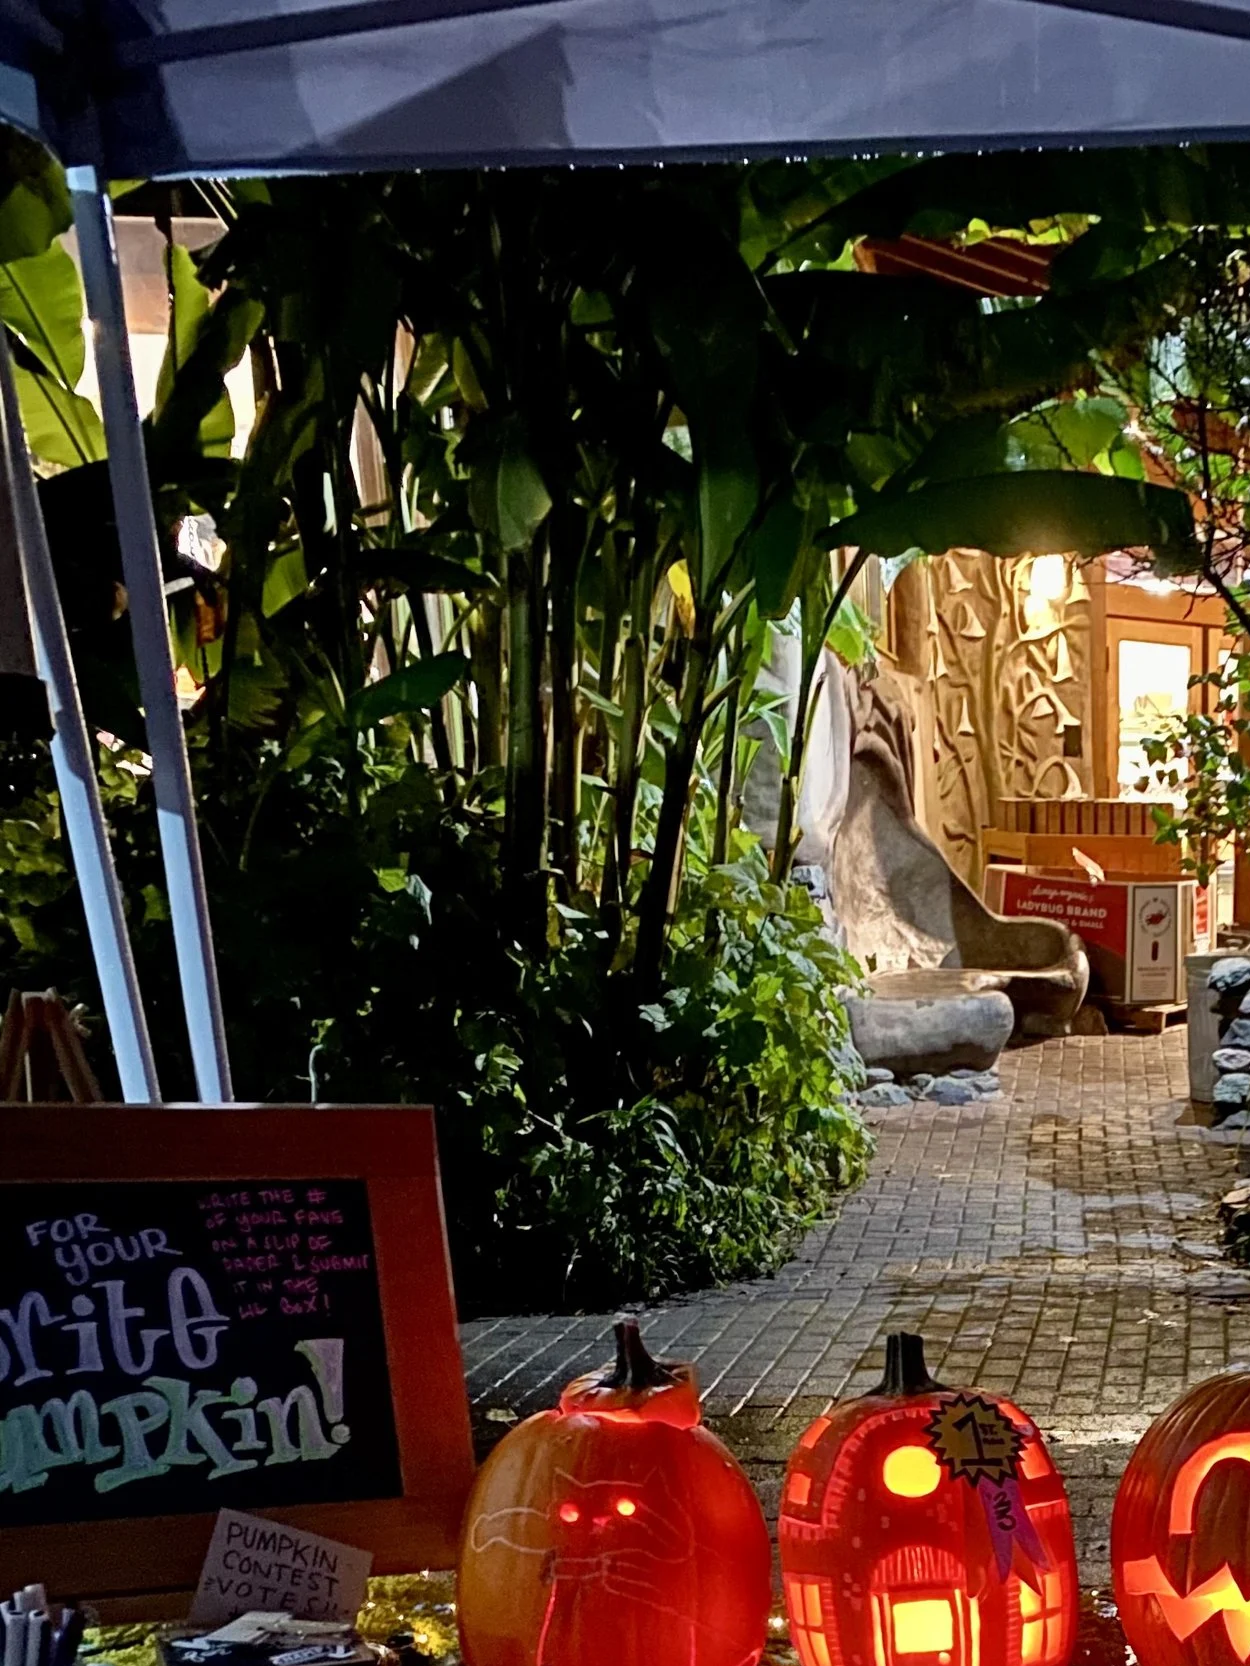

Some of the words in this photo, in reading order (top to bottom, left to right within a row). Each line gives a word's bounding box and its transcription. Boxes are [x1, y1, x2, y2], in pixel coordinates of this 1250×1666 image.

[1016, 899, 1064, 915] LADYBUG
[1066, 905, 1108, 918] BRAND
[257, 1188, 296, 1205] THE
[305, 1187, 328, 1205] #
[25, 1213, 111, 1247] FOR
[204, 1212, 227, 1230] OF
[234, 1209, 288, 1233] YOUR
[293, 1208, 345, 1226] FAVE
[211, 1235, 239, 1252] ON
[246, 1235, 258, 1251] A
[263, 1232, 301, 1251] SLIP
[307, 1235, 333, 1251] OF
[54, 1228, 183, 1286] YOUR
[309, 1253, 371, 1274] SUBMIT
[232, 1280, 248, 1295] IT
[256, 1279, 273, 1293] IN
[281, 1275, 319, 1294] THE
[0, 1338, 351, 1494] mpkin!
[227, 1521, 338, 1573] PUMPKIN
[223, 1550, 339, 1596] CONTEST
